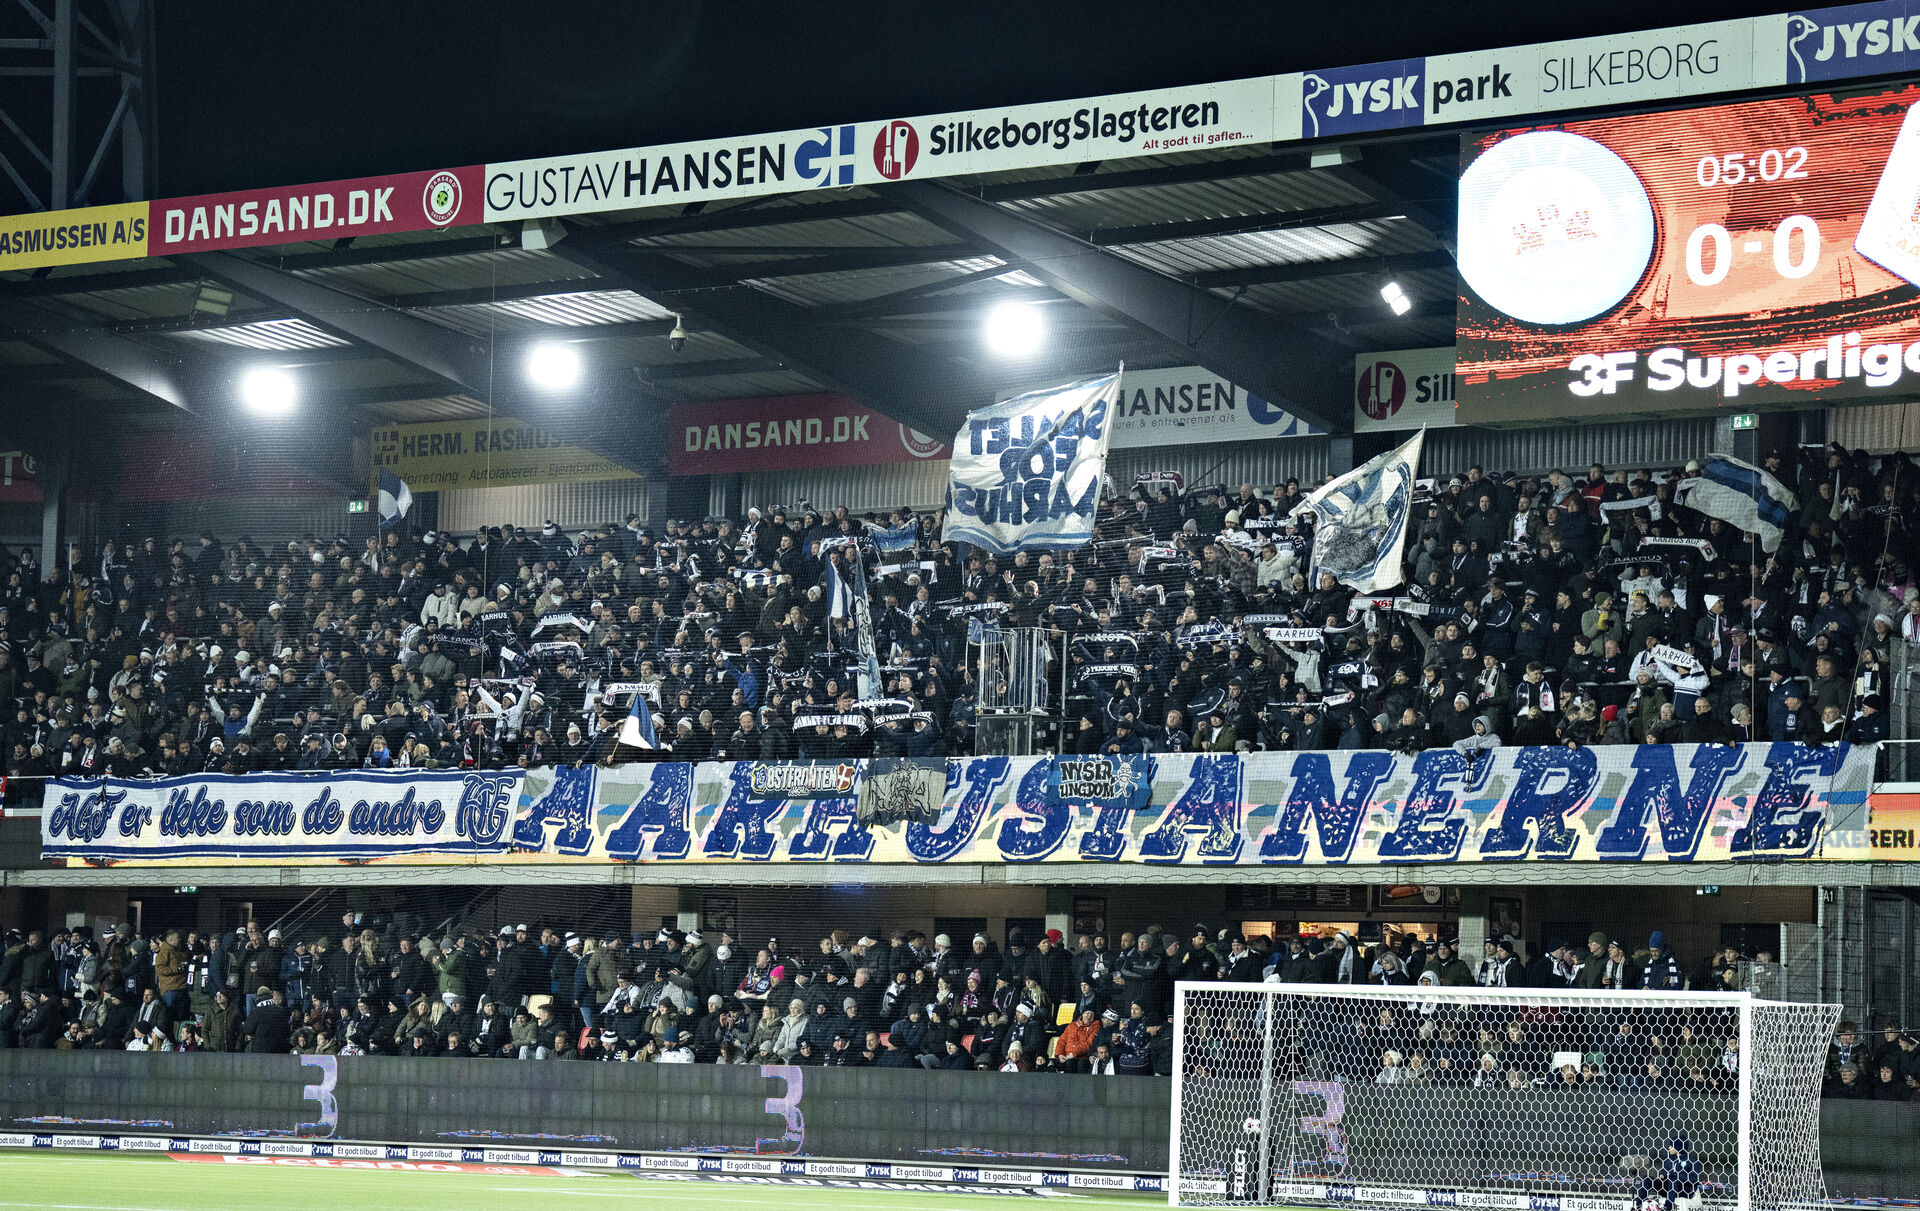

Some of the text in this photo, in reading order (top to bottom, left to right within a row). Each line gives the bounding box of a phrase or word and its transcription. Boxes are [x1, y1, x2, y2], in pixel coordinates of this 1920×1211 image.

[1815, 16, 1920, 63] JYSK
[1327, 40, 1719, 117] JYSK park SILKEBORG
[929, 99, 1219, 156] SilkeborgSlagteren
[1142, 139, 1159, 150] Alt
[1162, 136, 1190, 149] godt
[1194, 132, 1205, 145] til
[1697, 146, 1808, 188] 05:02
[165, 187, 395, 243] DANSAND.DK
[112, 218, 145, 244] A/S
[1568, 352, 1637, 397] 3F
[686, 414, 870, 452] DANSAND.DK
[402, 431, 467, 458] HERM.
[1275, 628, 1321, 638] AARHUS
[1654, 647, 1695, 665] AARHUS
[119, 803, 152, 838] er
[159, 785, 229, 837] ikke
[233, 800, 296, 836] som
[301, 786, 344, 834] de
[349, 786, 446, 836] andre
[36, 1136, 52, 1145] JYSK
[63, 1138, 76, 1146] godt
[103, 1138, 118, 1146] JYSK
[130, 1139, 143, 1148] godt
[144, 1140, 161, 1148] tilbud
[173, 1140, 188, 1149] JYSK
[200, 1141, 213, 1150] godt
[214, 1142, 232, 1150] tilbud
[244, 1142, 260, 1152] JYSK
[271, 1143, 285, 1152] godt
[286, 1144, 304, 1152] tilbud
[316, 1146, 333, 1155] JYSK
[345, 1147, 358, 1156] godt
[359, 1148, 378, 1156] tilbud
[390, 1148, 406, 1156] JYSK
[419, 1149, 433, 1158] godt
[434, 1149, 453, 1158] tilbud
[466, 1150, 483, 1160] JYSK
[495, 1151, 510, 1160] godt
[511, 1152, 530, 1160] tilbud
[543, 1153, 560, 1162] JYSK
[573, 1154, 588, 1164] godt
[589, 1155, 608, 1164] tilbud
[622, 1156, 640, 1166] JYSK
[653, 1158, 668, 1168] godt
[669, 1159, 689, 1168] tilbud
[702, 1158, 721, 1168] JYSK
[734, 1161, 750, 1170] godt
[751, 1161, 771, 1170] tilbud
[785, 1162, 804, 1172] JYSK
[810, 1164, 856, 1174] Et godt tilbud
[870, 1166, 890, 1176] JYSK
[904, 1168, 921, 1178] godt
[921, 1169, 943, 1178] tilbud
[957, 1170, 978, 1180] JYSK
[984, 1171, 1032, 1182] Et godt tilbud
[1046, 1173, 1067, 1184] JYSK
[1074, 1176, 1123, 1186] Et godt tilbud
[1138, 1178, 1160, 1188] JYSK
